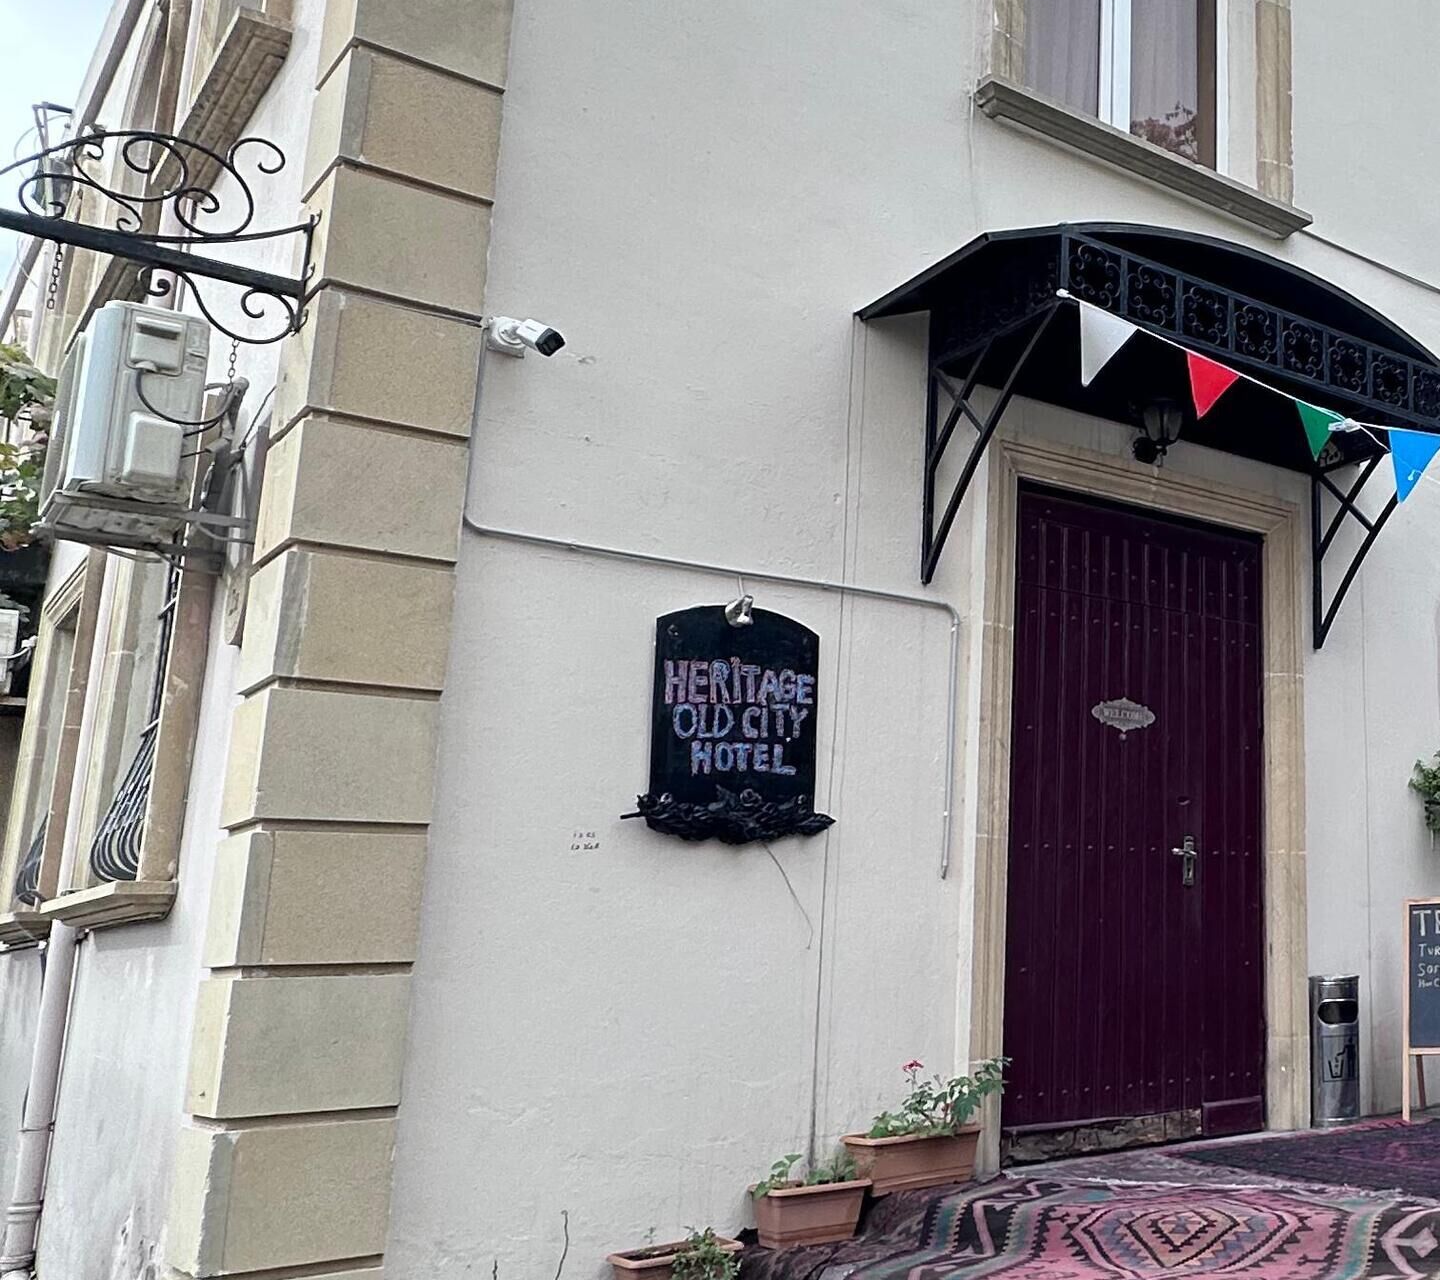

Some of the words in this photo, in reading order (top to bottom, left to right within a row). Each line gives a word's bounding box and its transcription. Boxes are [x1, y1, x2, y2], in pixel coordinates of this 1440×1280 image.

[663, 656, 815, 705] HERITAGE
[672, 703, 735, 739] OLD
[742, 702, 808, 739] CITY
[690, 740, 796, 775] HOTEL
